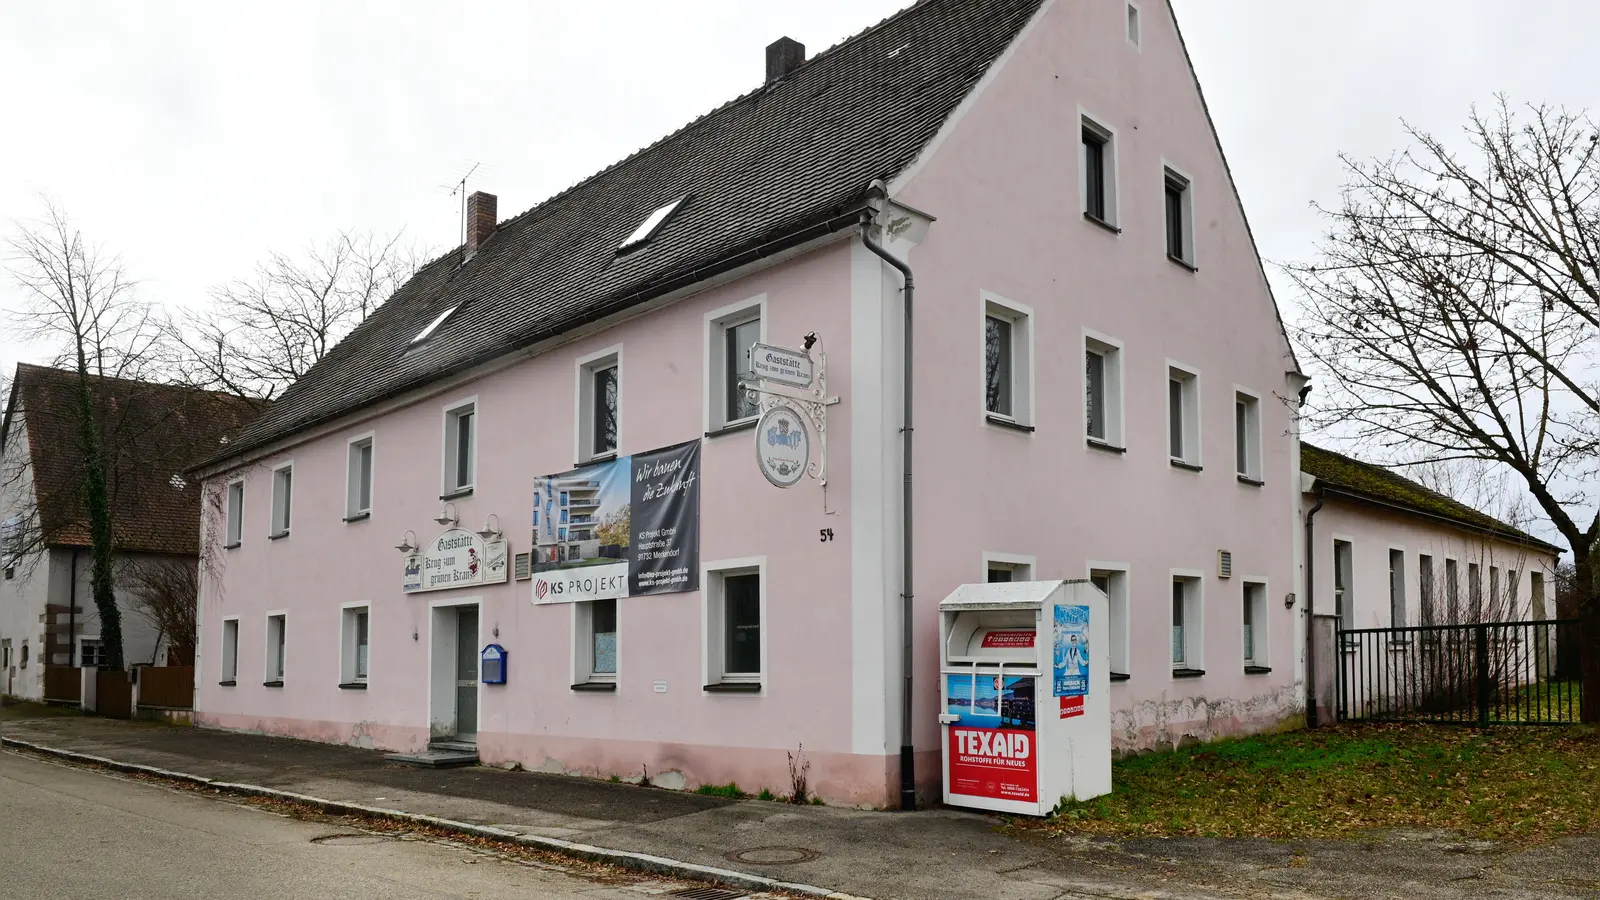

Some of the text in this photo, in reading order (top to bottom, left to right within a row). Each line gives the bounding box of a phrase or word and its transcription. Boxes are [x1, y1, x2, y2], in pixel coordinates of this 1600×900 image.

[755, 361, 769, 371] Krug
[766, 353, 801, 369] Gaststätte
[636, 459, 681, 482] Wir bauen
[643, 471, 696, 501] die Zukunft
[638, 527, 677, 540] KS Projekt GmbH
[820, 528, 834, 542] 54
[437, 534, 473, 551] Gaststätte
[638, 540, 666, 550] Hauptstraße
[425, 557, 441, 570] Krug
[444, 556, 455, 567] zum
[638, 552, 653, 561] 91732
[431, 571, 452, 586] grünen
[550, 575, 624, 595] KS PROJEKT
[955, 730, 1030, 759] TEXAID
[960, 755, 992, 764] ROHSTOFFE
[993, 757, 1005, 765] FÜR
